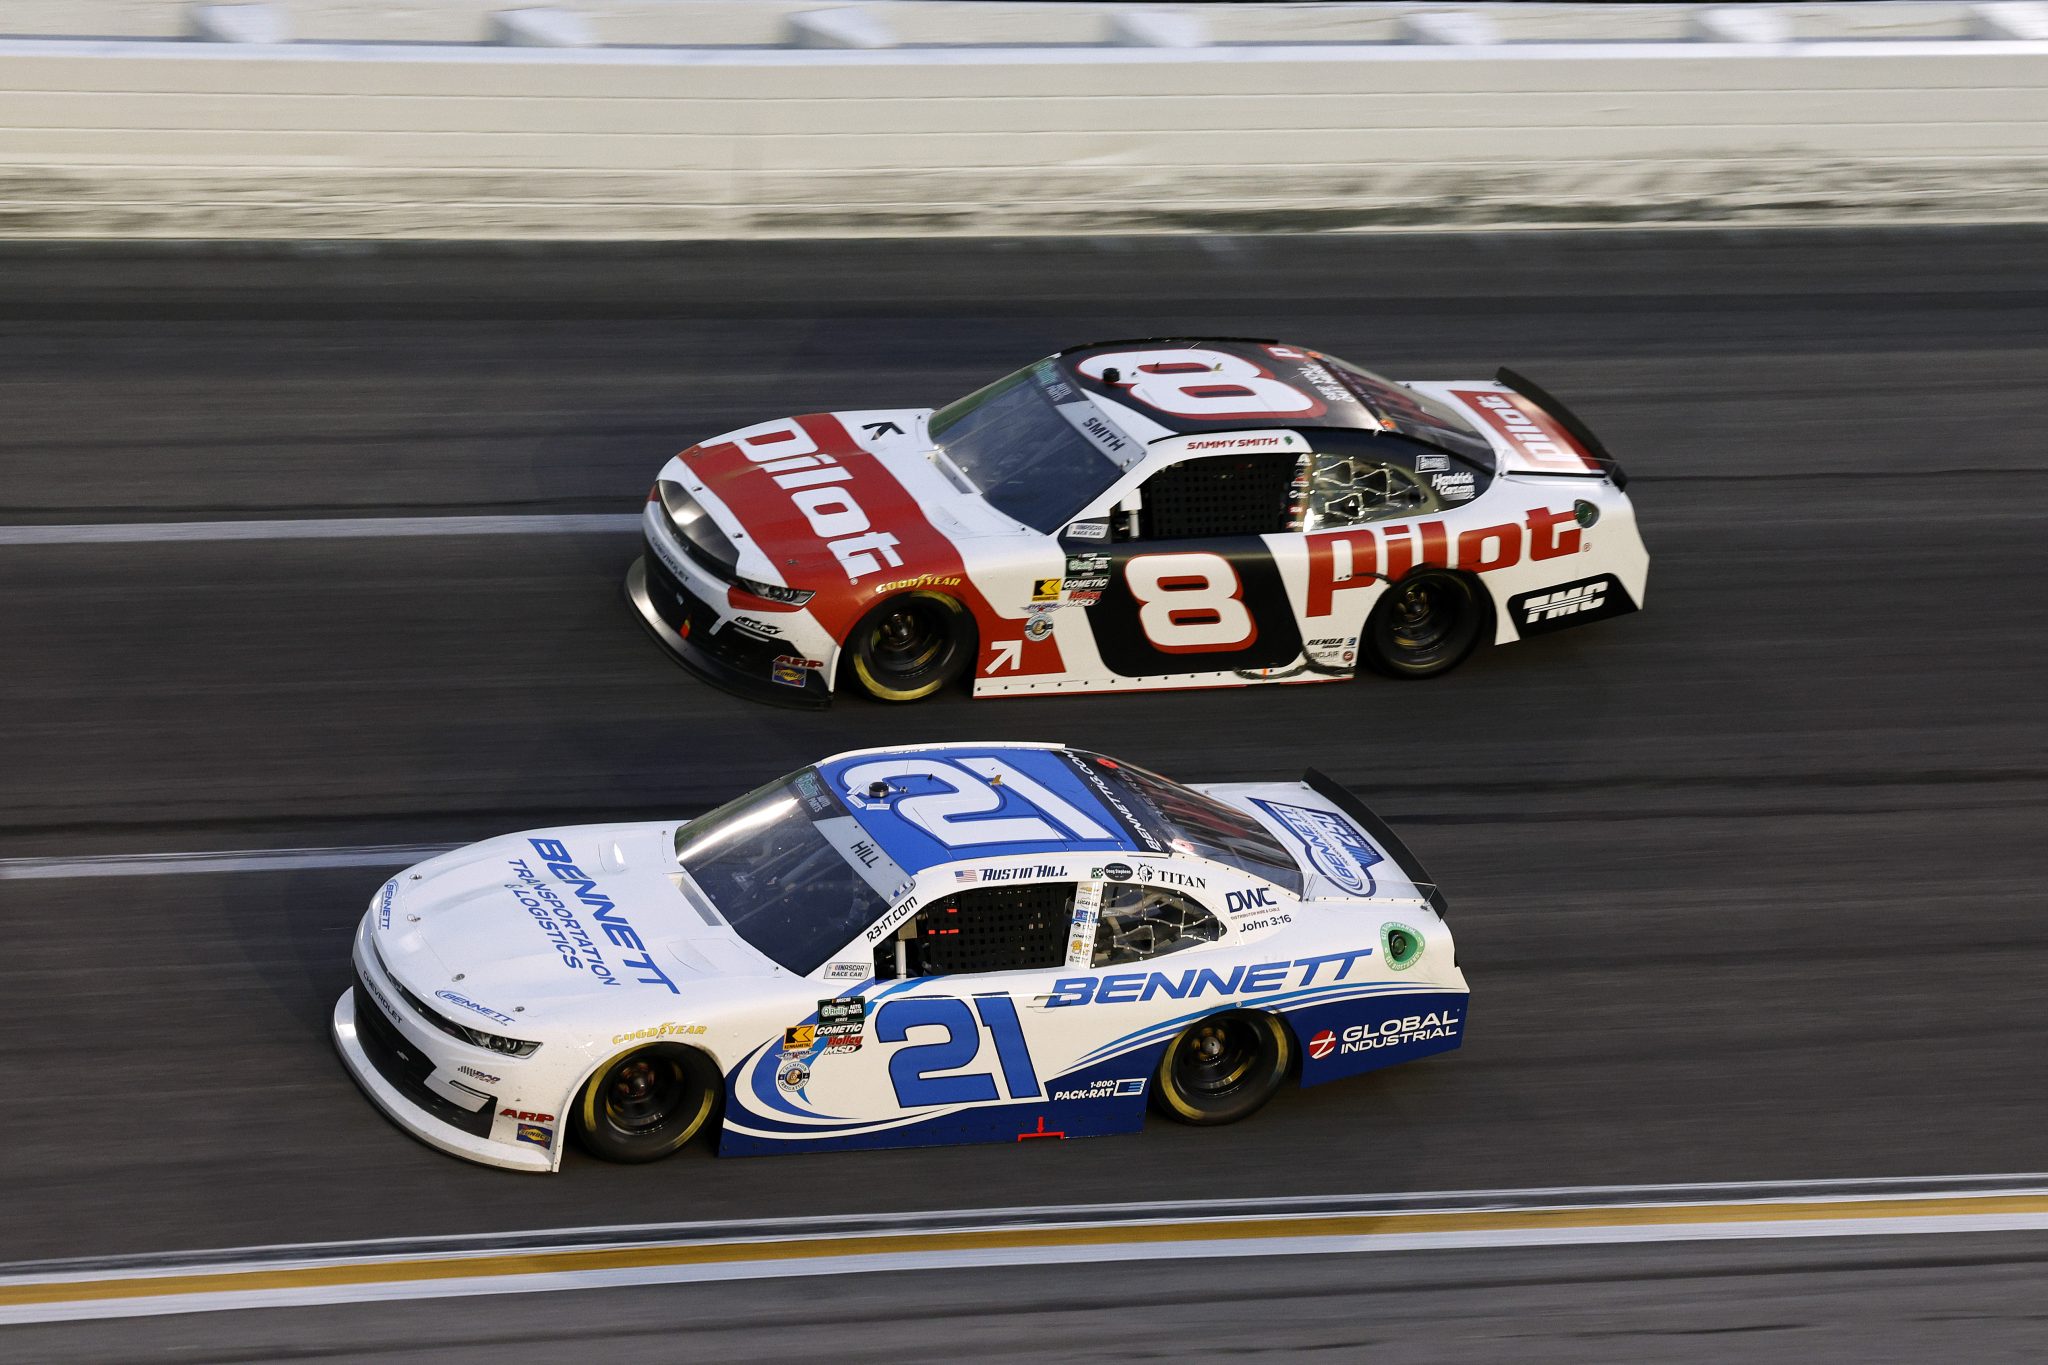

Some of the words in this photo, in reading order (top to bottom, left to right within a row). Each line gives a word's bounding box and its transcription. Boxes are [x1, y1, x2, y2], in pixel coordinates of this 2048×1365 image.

[1078, 348, 1327, 420] 8
[1083, 418, 1126, 452] SMITH
[1187, 440, 1234, 450] SAMMY
[1236, 437, 1279, 448] SMITH
[875, 573, 962, 594] GOODYEAR
[1063, 577, 1109, 589] COMETIC
[1124, 552, 1258, 655] 8
[1523, 581, 1609, 625] TMC
[1306, 637, 1344, 646] RENDA
[776, 654, 824, 669] ARP
[837, 757, 1125, 848] 21
[850, 841, 879, 869] HILL
[1274, 806, 1355, 879] BENNETT
[979, 868, 1033, 881] AUSTIN
[1033, 865, 1068, 878] HILL
[1158, 870, 1206, 889] TITAN
[382, 884, 394, 930] BENNETT
[1225, 887, 1278, 913] DWC
[508, 858, 622, 986] TRANSPORTATION
[512, 889, 584, 970] LOGISTICS
[528, 838, 681, 995] BENNETT
[1240, 920, 1269, 933] John
[1269, 914, 1292, 926] 3:16
[1045, 948, 1373, 1009] BENNETT
[363, 970, 403, 1024] CHEVROLET
[442, 993, 516, 1022] BENNETT
[612, 1022, 708, 1046] GOODYEAR
[817, 1023, 863, 1035] COMETIC
[1342, 1010, 1459, 1042] GLOBAL
[823, 1045, 857, 1055] MSD
[827, 1035, 863, 1047] Holley
[875, 992, 1043, 1109] 21
[1340, 1026, 1457, 1055] INDUSTRIAL
[1054, 1087, 1114, 1101] PACK-RAT
[1090, 1080, 1116, 1088] 1-800-
[499, 1108, 555, 1123] ARP
[519, 1128, 552, 1142] SUNOCO
